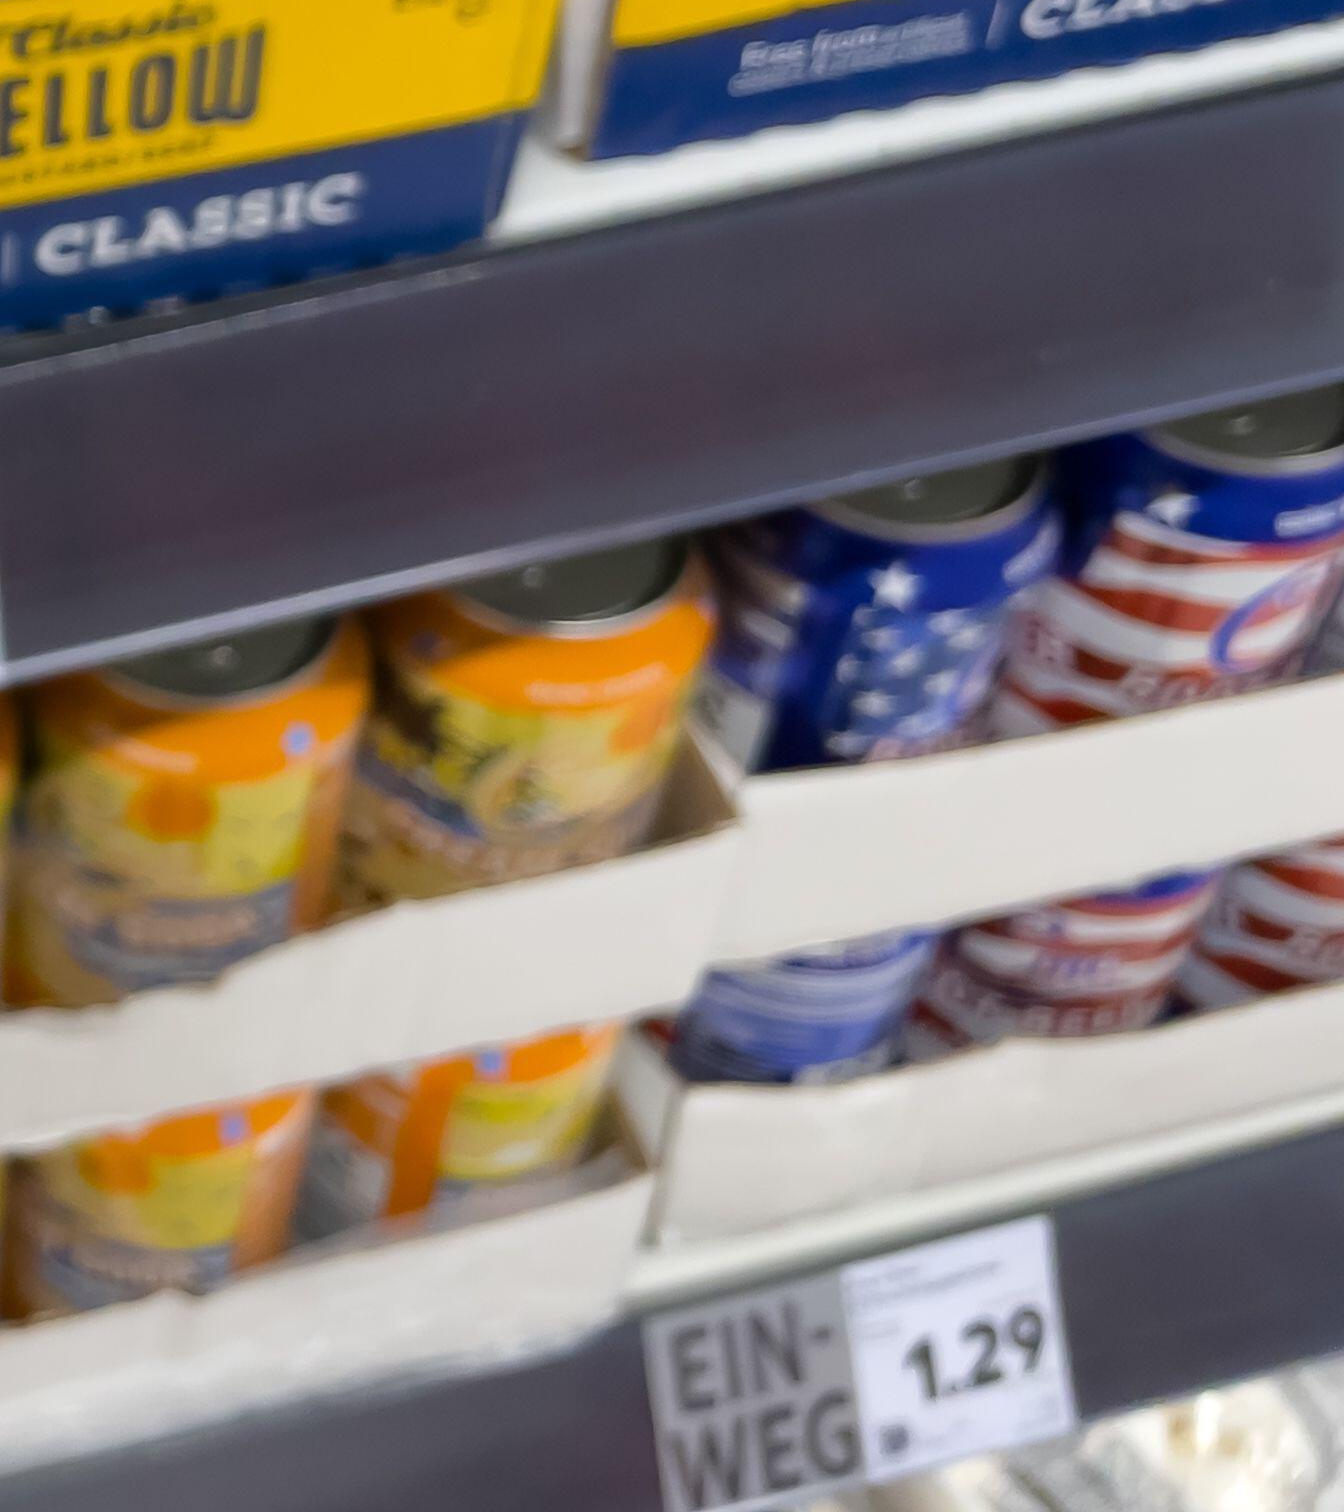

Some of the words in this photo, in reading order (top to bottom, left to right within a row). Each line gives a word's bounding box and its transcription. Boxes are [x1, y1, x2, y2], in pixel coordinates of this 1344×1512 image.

[34, 172, 363, 278] CLASSIC
[667, 1298, 832, 1413] EIN-
[904, 1305, 1046, 1402] 1.29
[665, 1391, 865, 1508] WEG
